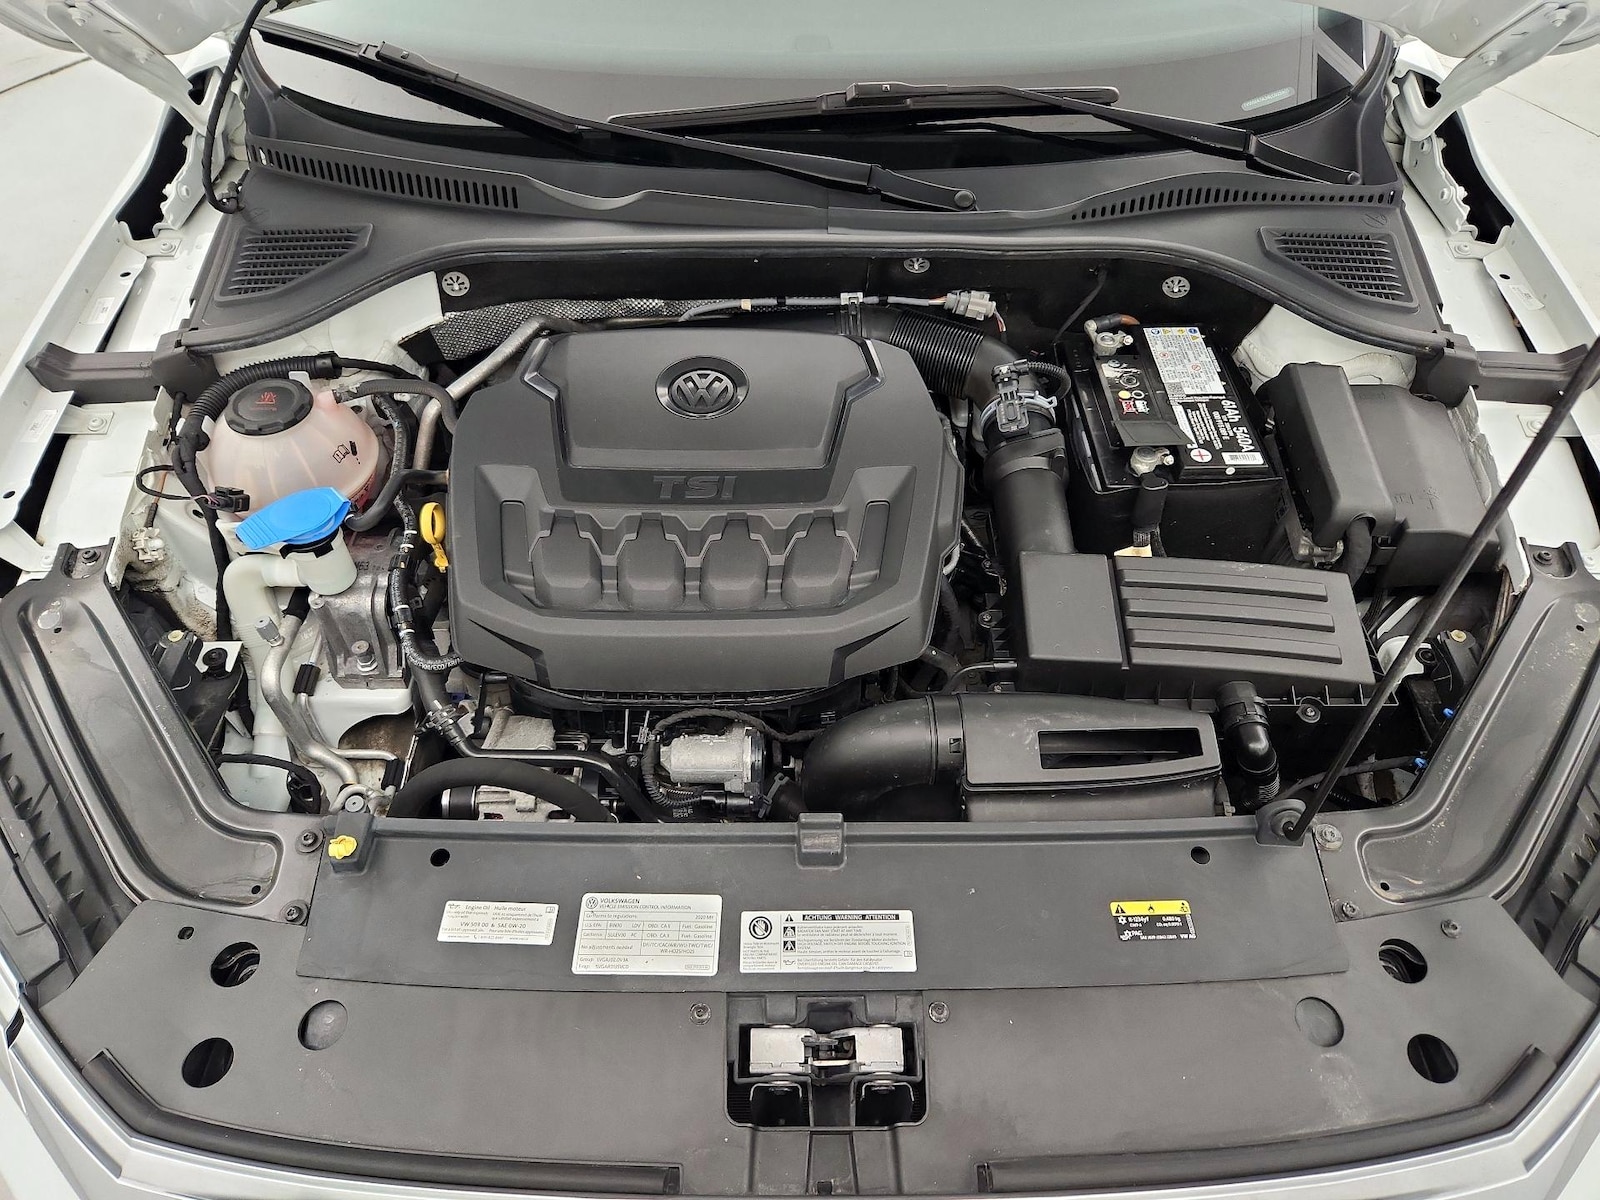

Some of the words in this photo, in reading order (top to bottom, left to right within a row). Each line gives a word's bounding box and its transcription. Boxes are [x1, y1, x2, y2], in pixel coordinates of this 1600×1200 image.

[1221, 400, 1241, 423] 61Ah
[1232, 426, 1255, 452] 540A
[653, 475, 738, 499] TSI
